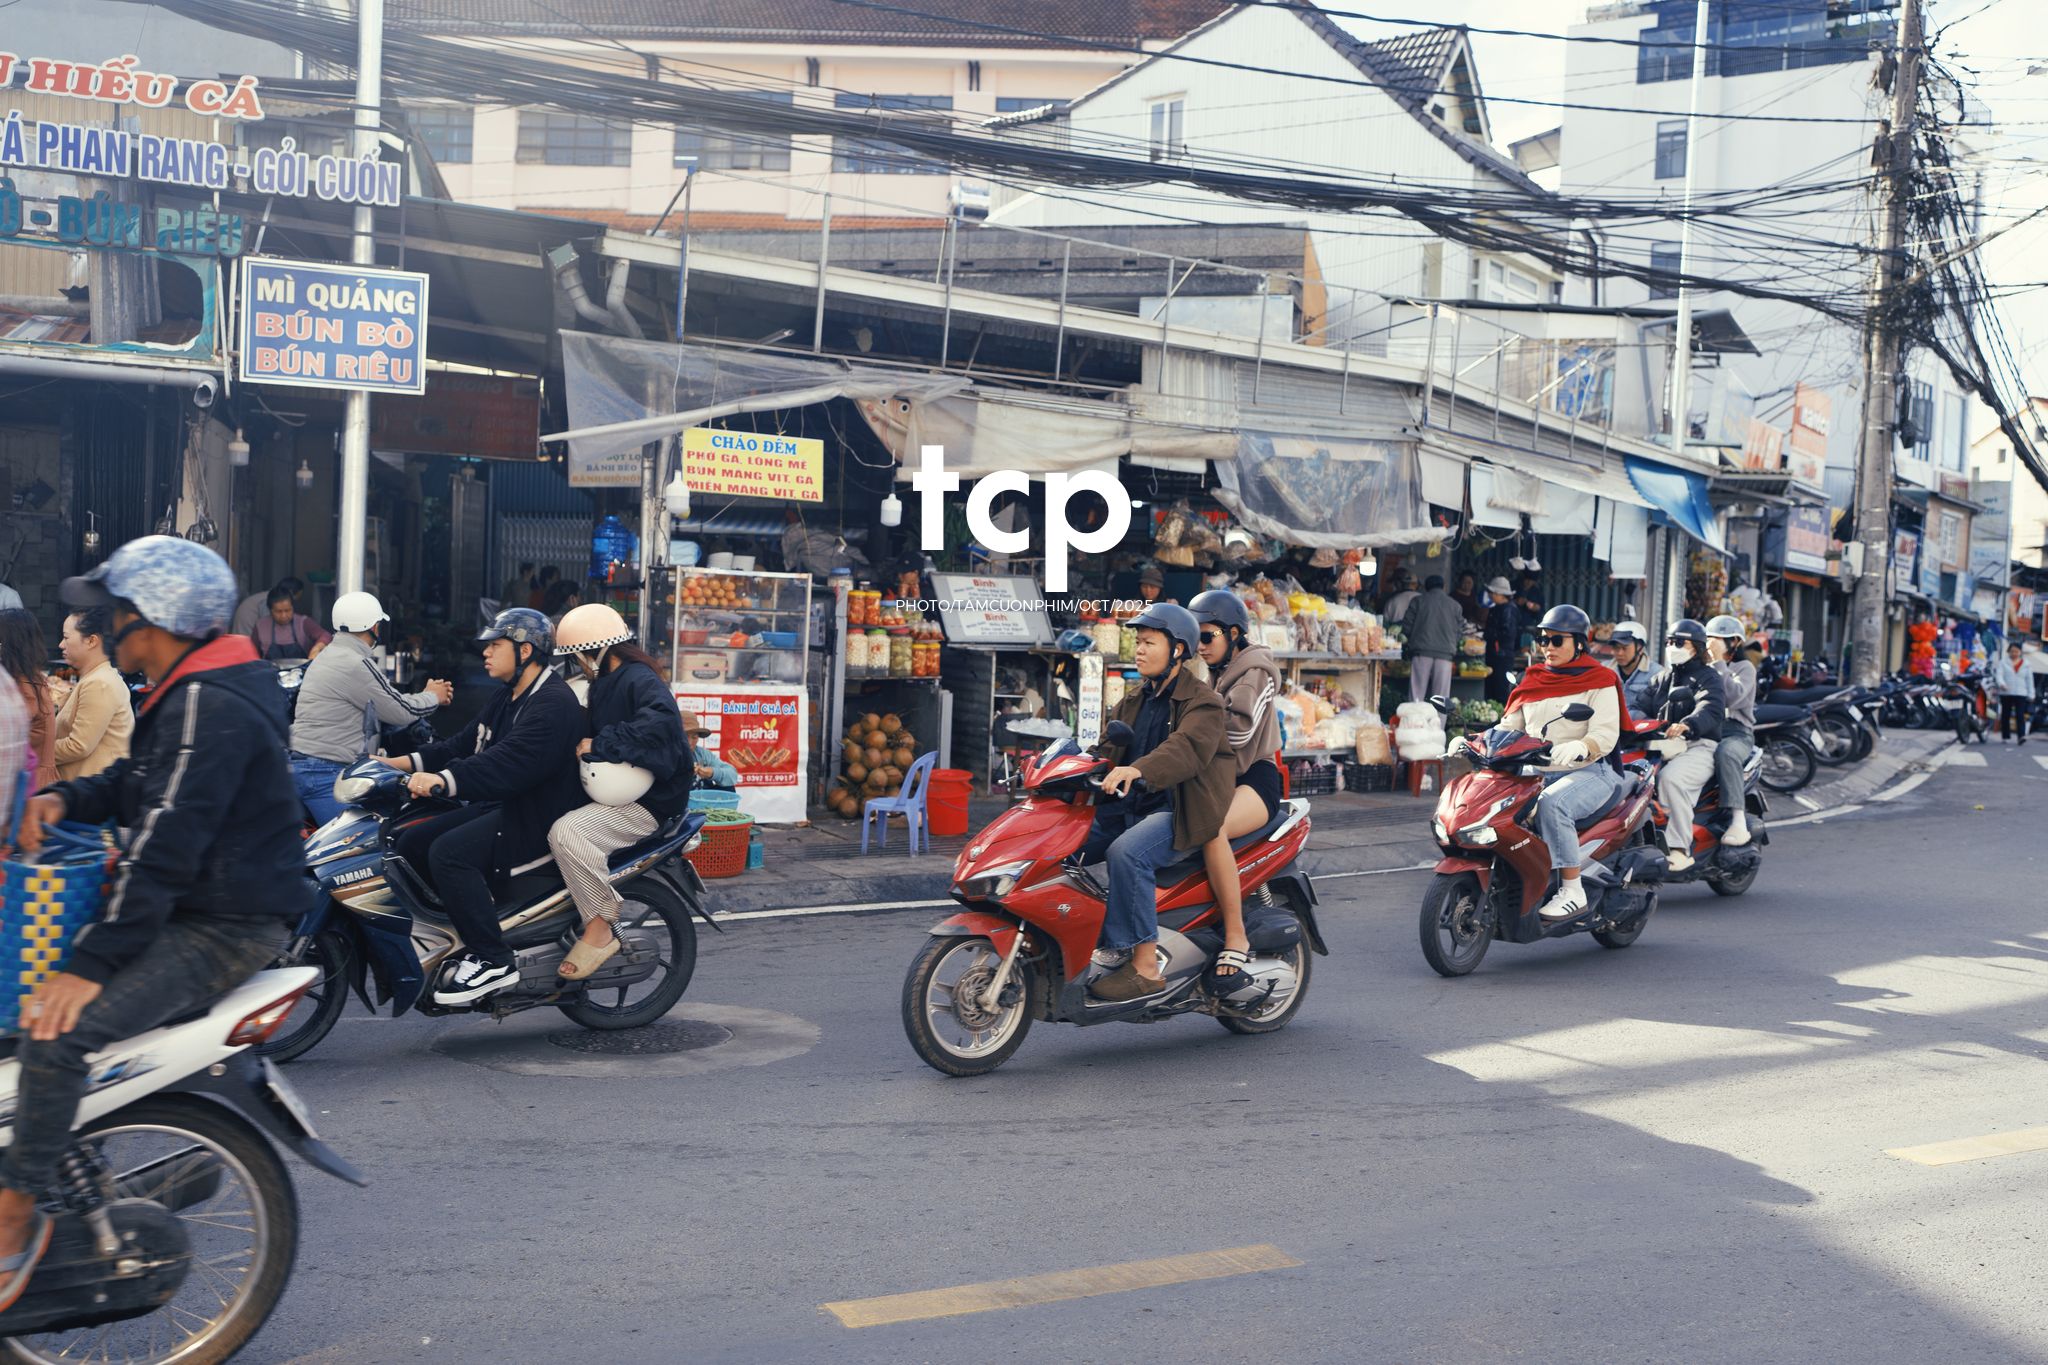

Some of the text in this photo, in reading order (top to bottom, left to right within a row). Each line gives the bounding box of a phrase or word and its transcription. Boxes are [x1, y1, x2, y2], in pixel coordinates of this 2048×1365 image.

[38, 122, 128, 175] PHAN
[140, 135, 226, 188] RANG
[256, 137, 308, 196] GỎI
[317, 146, 400, 206] CUỐN
[58, 190, 143, 249] BÚN
[155, 202, 246, 256] RIÊU
[256, 273, 416, 315] MÌ QUẢNG
[255, 309, 414, 349] BÚN BÒ
[255, 343, 413, 383] BÚN RIÊU
[711, 434, 797, 455] CHÁO ĐÊM
[723, 699, 748, 714] BÁNH
[749, 700, 760, 714] MÌ
[1510, 837, 1530, 850] 125
[333, 867, 374, 886] YAMAHA
